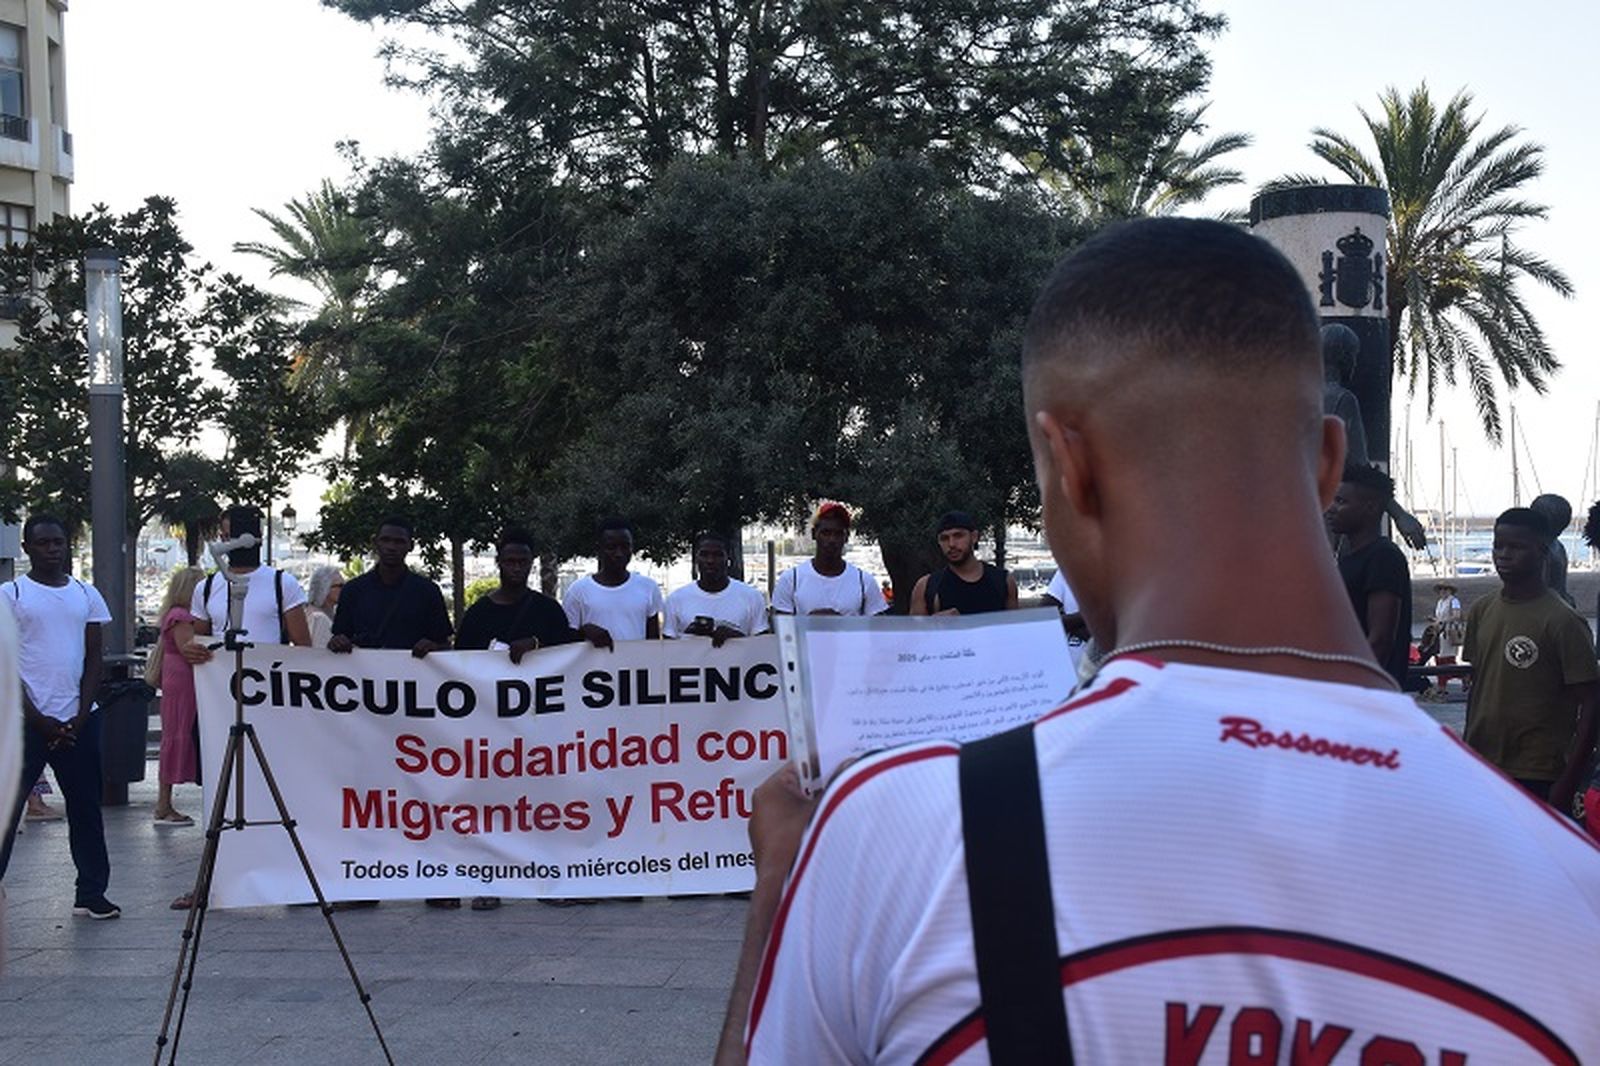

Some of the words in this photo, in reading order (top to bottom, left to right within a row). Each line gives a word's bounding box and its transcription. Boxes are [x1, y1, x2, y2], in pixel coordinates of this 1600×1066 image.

[230, 662, 477, 718] CÍRCULO
[496, 674, 565, 718] DE
[395, 723, 680, 779] Solidaridad
[697, 728, 788, 762] con
[1219, 715, 1401, 770] Rossoneri
[341, 787, 591, 841] Migrantes
[604, 795, 634, 838] y
[341, 860, 409, 879] Todos
[416, 859, 449, 878] los
[454, 861, 562, 883] segundos
[567, 855, 672, 879] miércoles
[678, 851, 710, 871] del
